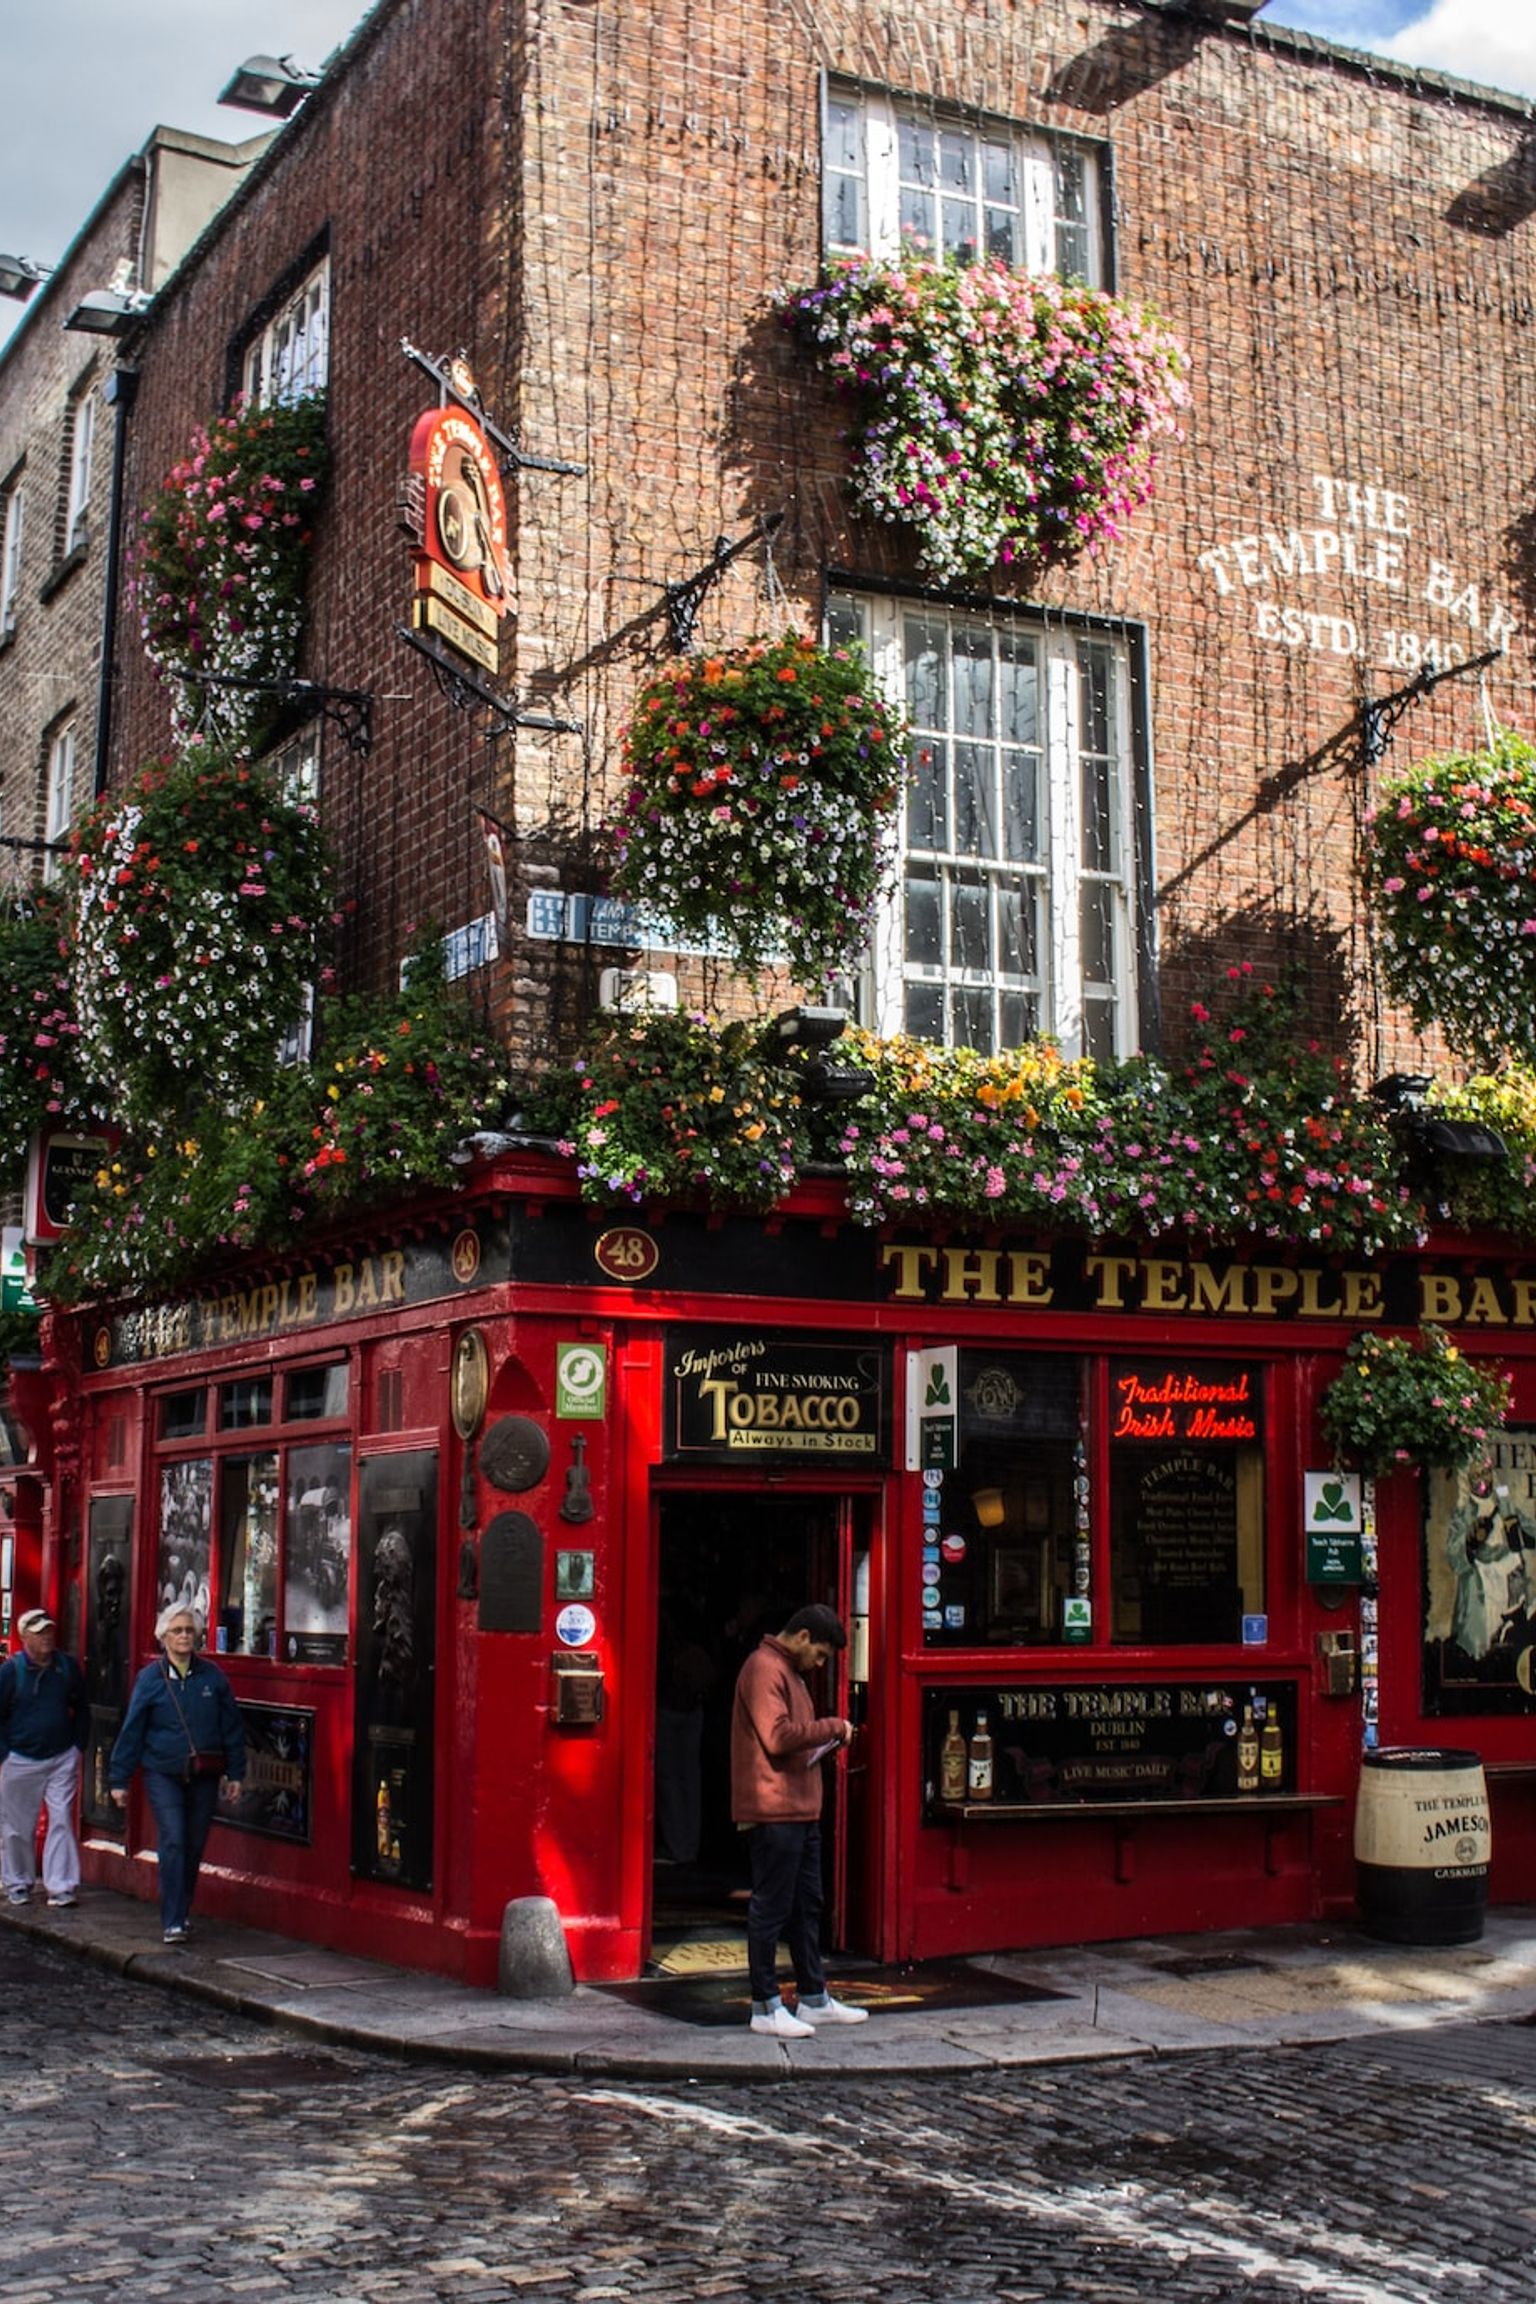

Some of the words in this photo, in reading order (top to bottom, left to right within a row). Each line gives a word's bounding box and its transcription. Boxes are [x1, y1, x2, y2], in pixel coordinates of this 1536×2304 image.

[1312, 474, 1412, 538] THE
[1199, 528, 1405, 597] TEMPLE
[1425, 559, 1520, 655] BAR
[605, 1237, 646, 1268] 48
[200, 1272, 319, 1342] TEMPLE
[332, 1250, 407, 1314] BAR
[883, 1244, 1056, 1306] THE
[1086, 1255, 1387, 1320] TEMPLE
[673, 1339, 767, 1383] Importers
[731, 1362, 748, 1376] OF
[755, 1372, 790, 1389] FINE
[791, 1374, 860, 1391] SMOKING
[1117, 1373, 1250, 1405] Traditional
[698, 1379, 861, 1441] TOBACCO
[1113, 1405, 1176, 1438] Irish
[1185, 1408, 1257, 1438] Music
[731, 1431, 794, 1448] Always
[802, 1433, 818, 1447] in
[823, 1432, 874, 1449] Stock
[1489, 1442, 1536, 1469] TE
[1139, 1456, 1203, 1489] TEMPLE
[1206, 1462, 1235, 1491] BAR
[999, 1691, 1056, 1720] THE
[1063, 1690, 1172, 1719] TEMPLE
[1089, 1720, 1146, 1738] DUBLIN
[1063, 1764, 1094, 1782] LIVE
[1095, 1764, 1132, 1780] MUSIC
[1134, 1761, 1172, 1778] DAILY
[1414, 1799, 1440, 1812] THE
